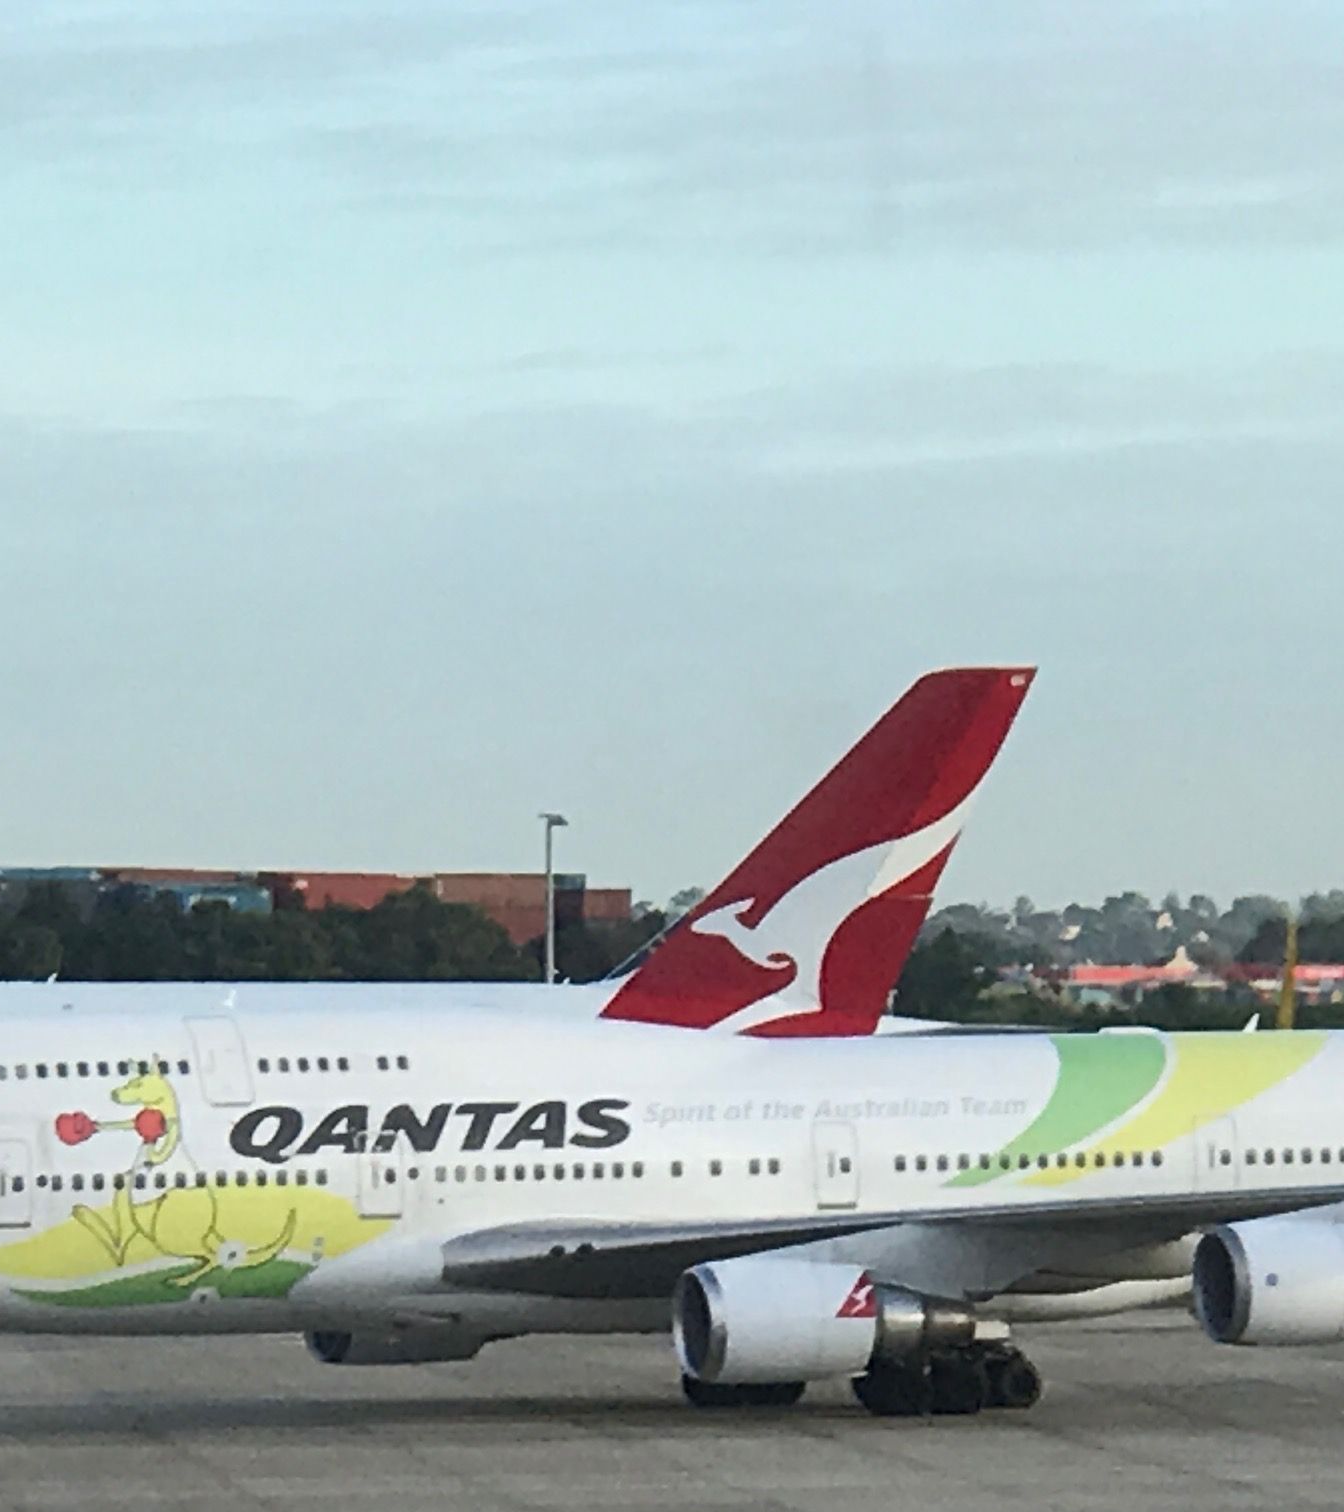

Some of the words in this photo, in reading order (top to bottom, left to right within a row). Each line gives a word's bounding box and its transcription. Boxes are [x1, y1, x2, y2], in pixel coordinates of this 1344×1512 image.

[229, 1098, 631, 1164] QANTAS
[643, 1102, 716, 1127] Spirit
[723, 1100, 754, 1122] of
[761, 1100, 806, 1121] the
[812, 1098, 950, 1121] Australian
[959, 1096, 1029, 1117] Team
